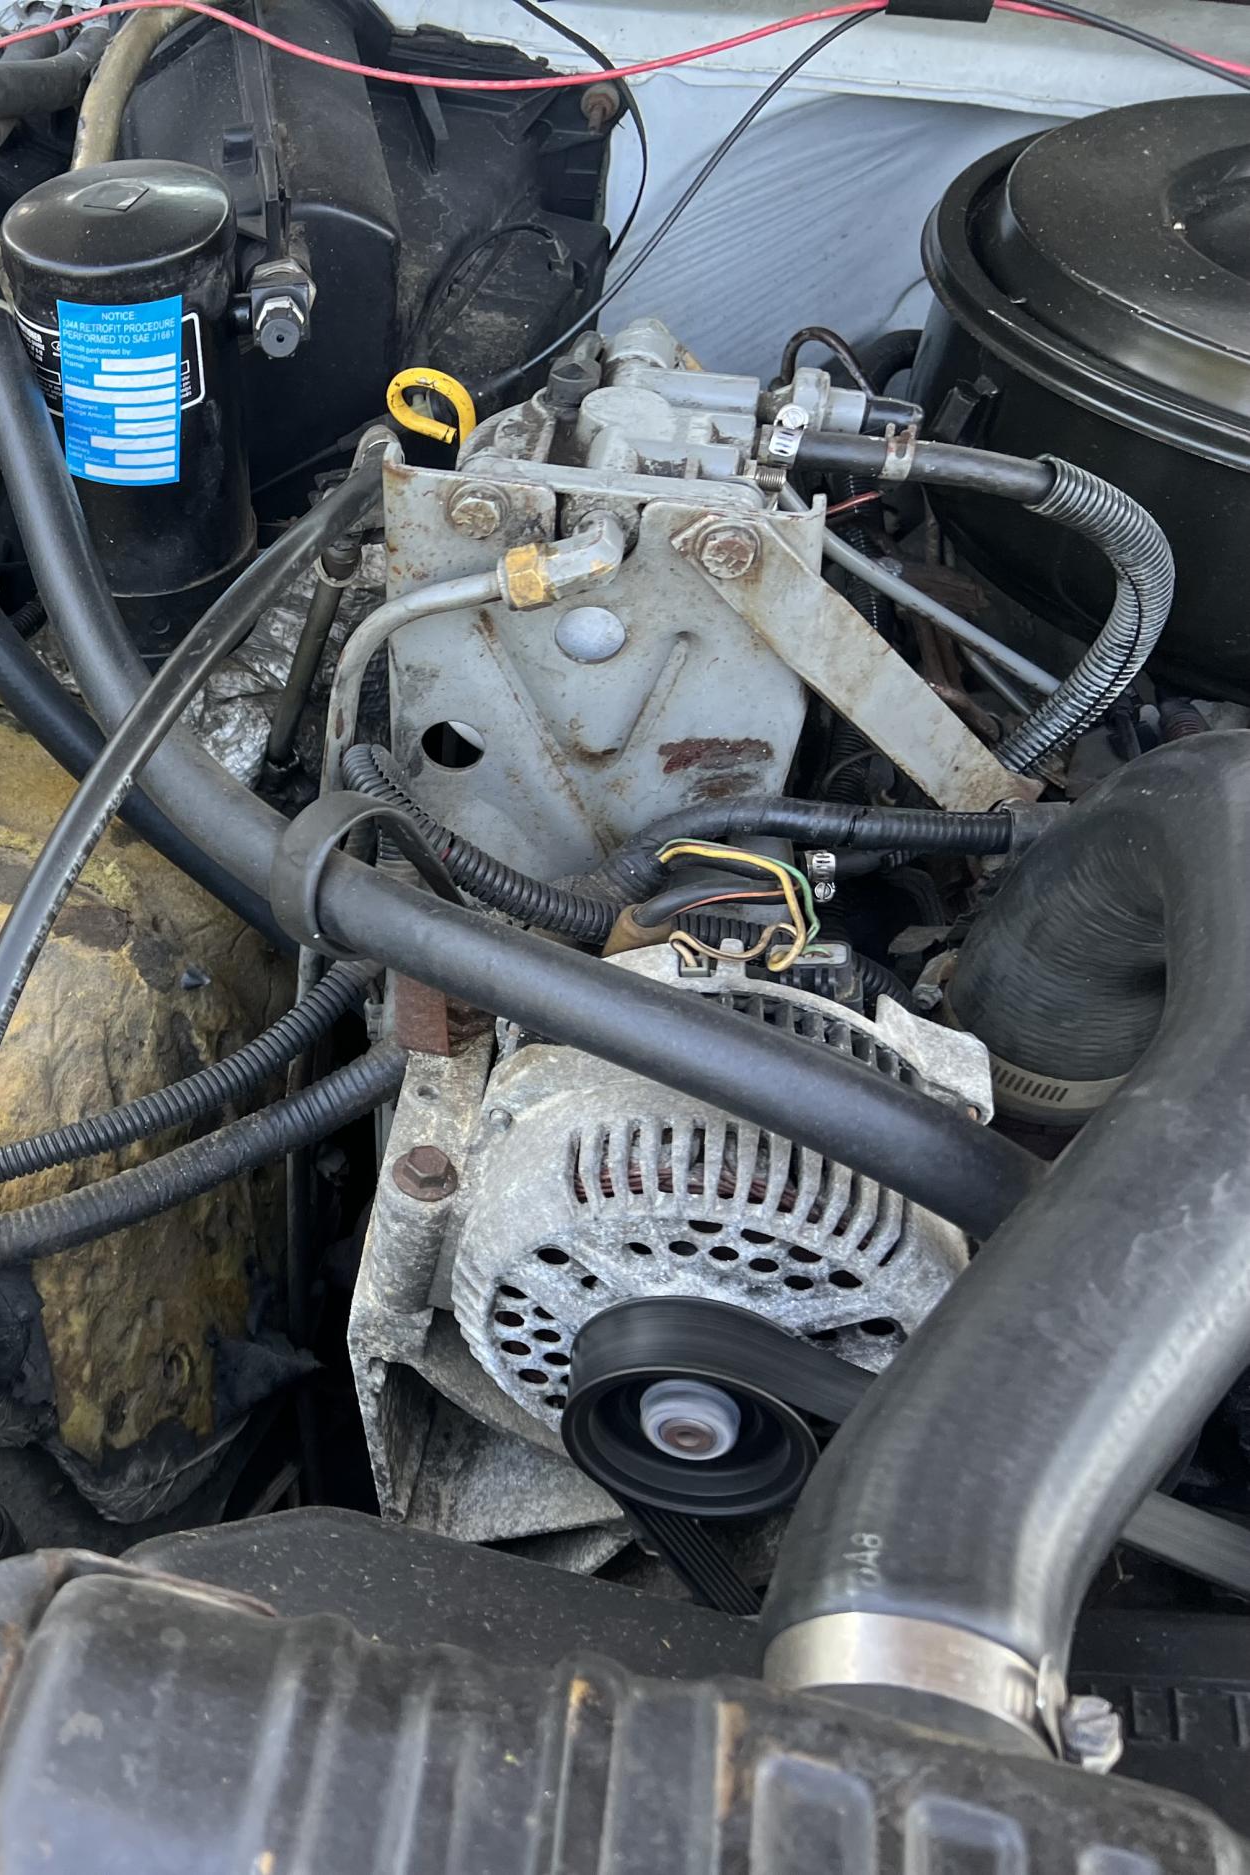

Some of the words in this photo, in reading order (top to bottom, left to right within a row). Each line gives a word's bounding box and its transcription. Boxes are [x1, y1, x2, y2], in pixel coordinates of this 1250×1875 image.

[101, 311, 135, 321] NOTICE
[80, 323, 121, 333] RETROFIT
[124, 318, 175, 333] PROCEDURE
[63, 329, 116, 344] PERFORMED
[118, 335, 131, 344] TO
[133, 333, 150, 343] SAE
